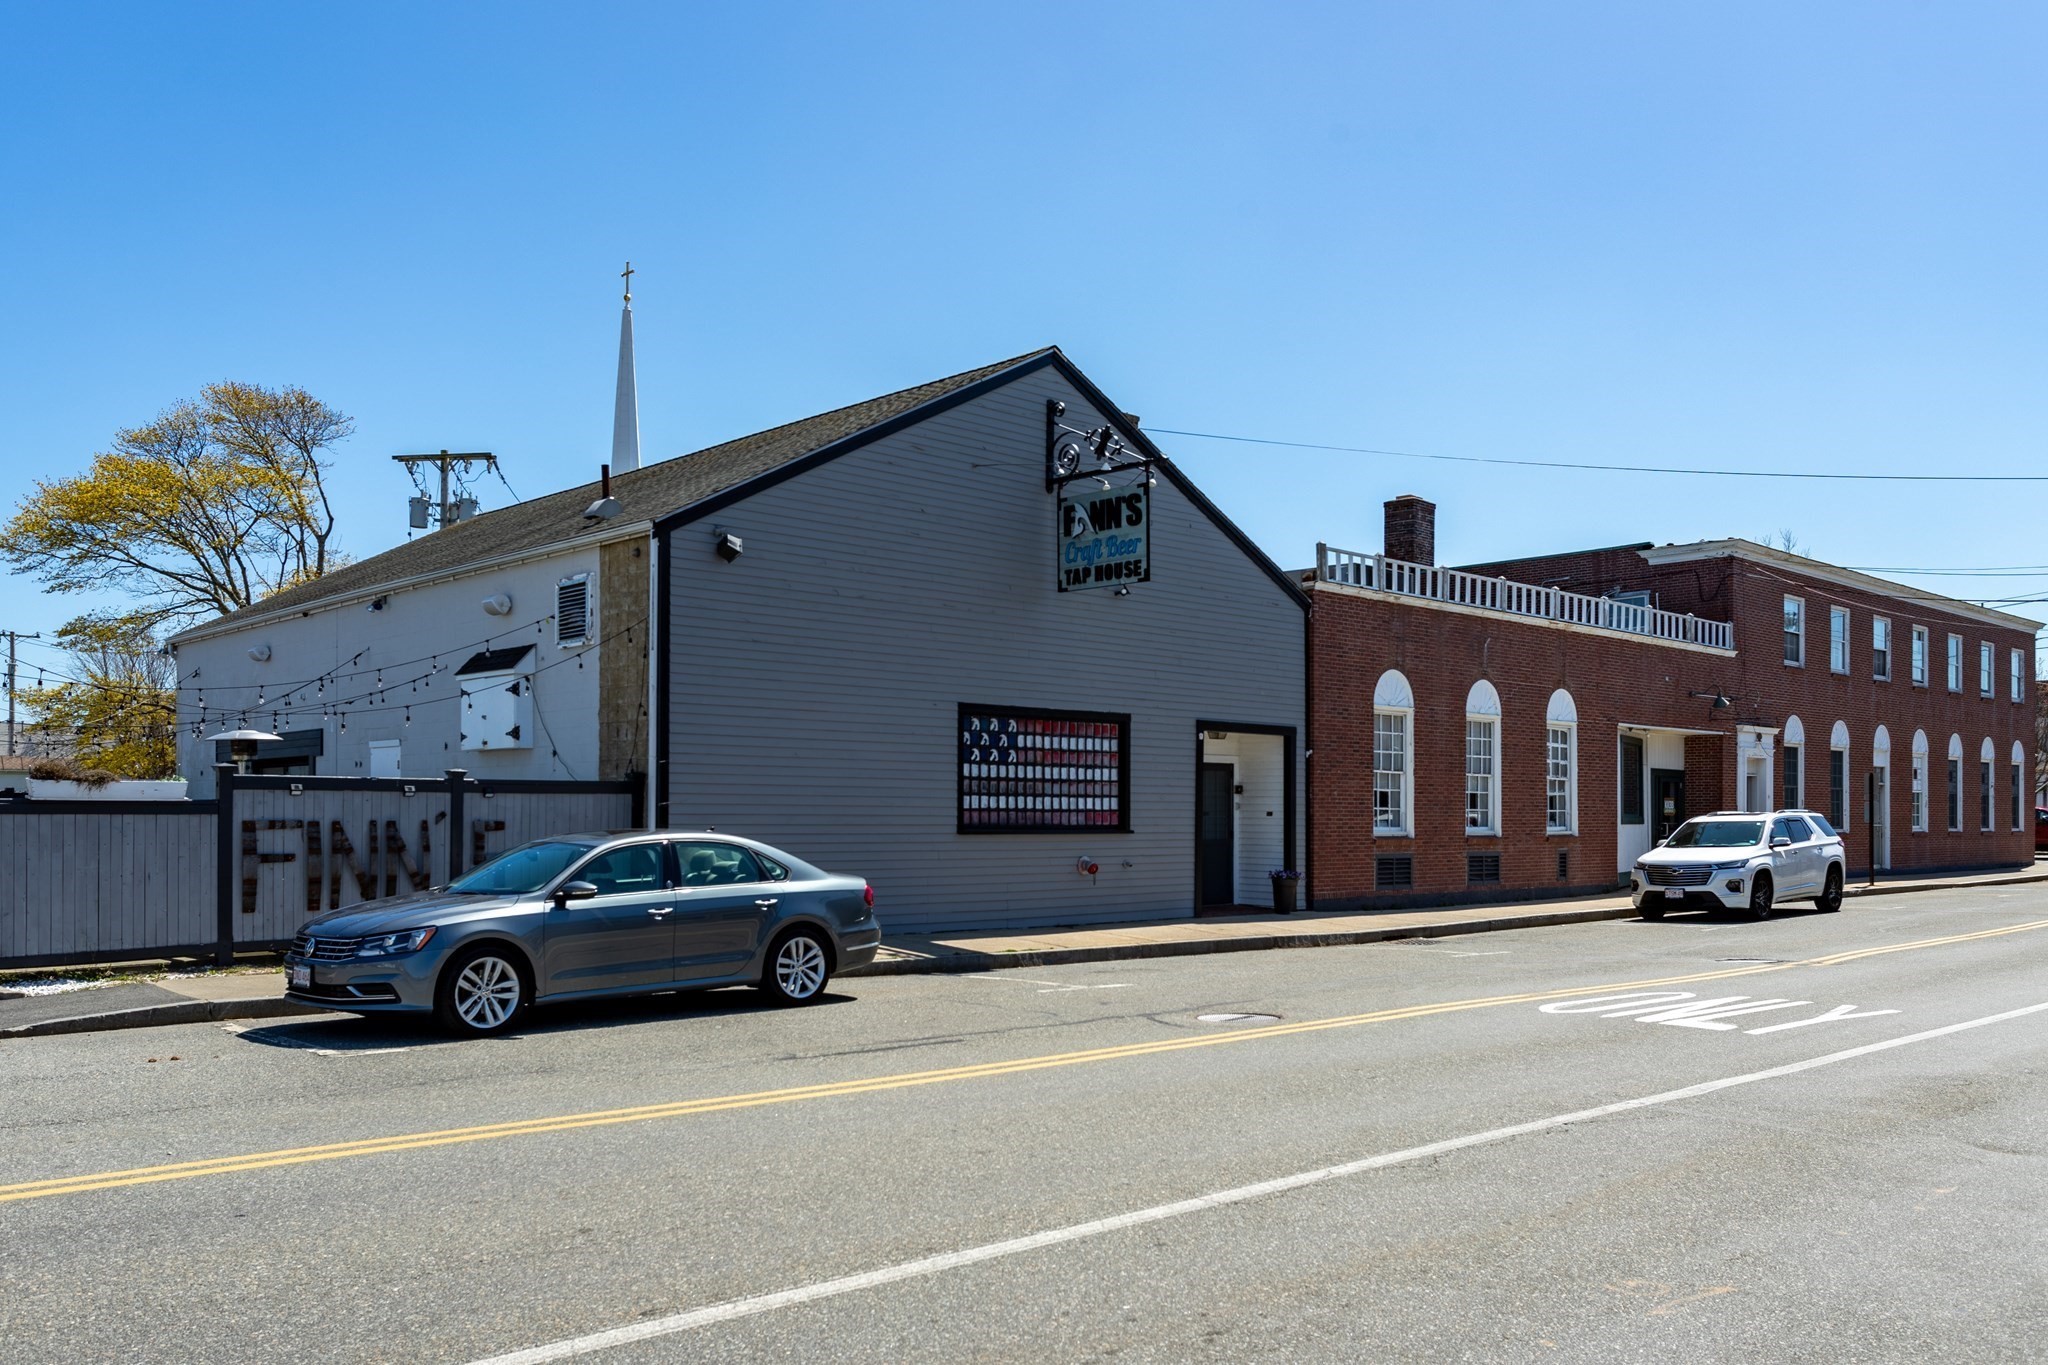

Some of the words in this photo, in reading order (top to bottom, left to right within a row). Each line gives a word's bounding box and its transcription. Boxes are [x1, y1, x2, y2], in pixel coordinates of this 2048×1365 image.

[1064, 538, 1103, 566] Craft
[1106, 535, 1142, 558] Beer
[1064, 566, 1091, 586] TAP
[1094, 559, 1142, 582] HOUSE
[1539, 991, 1902, 1035] ONLY
